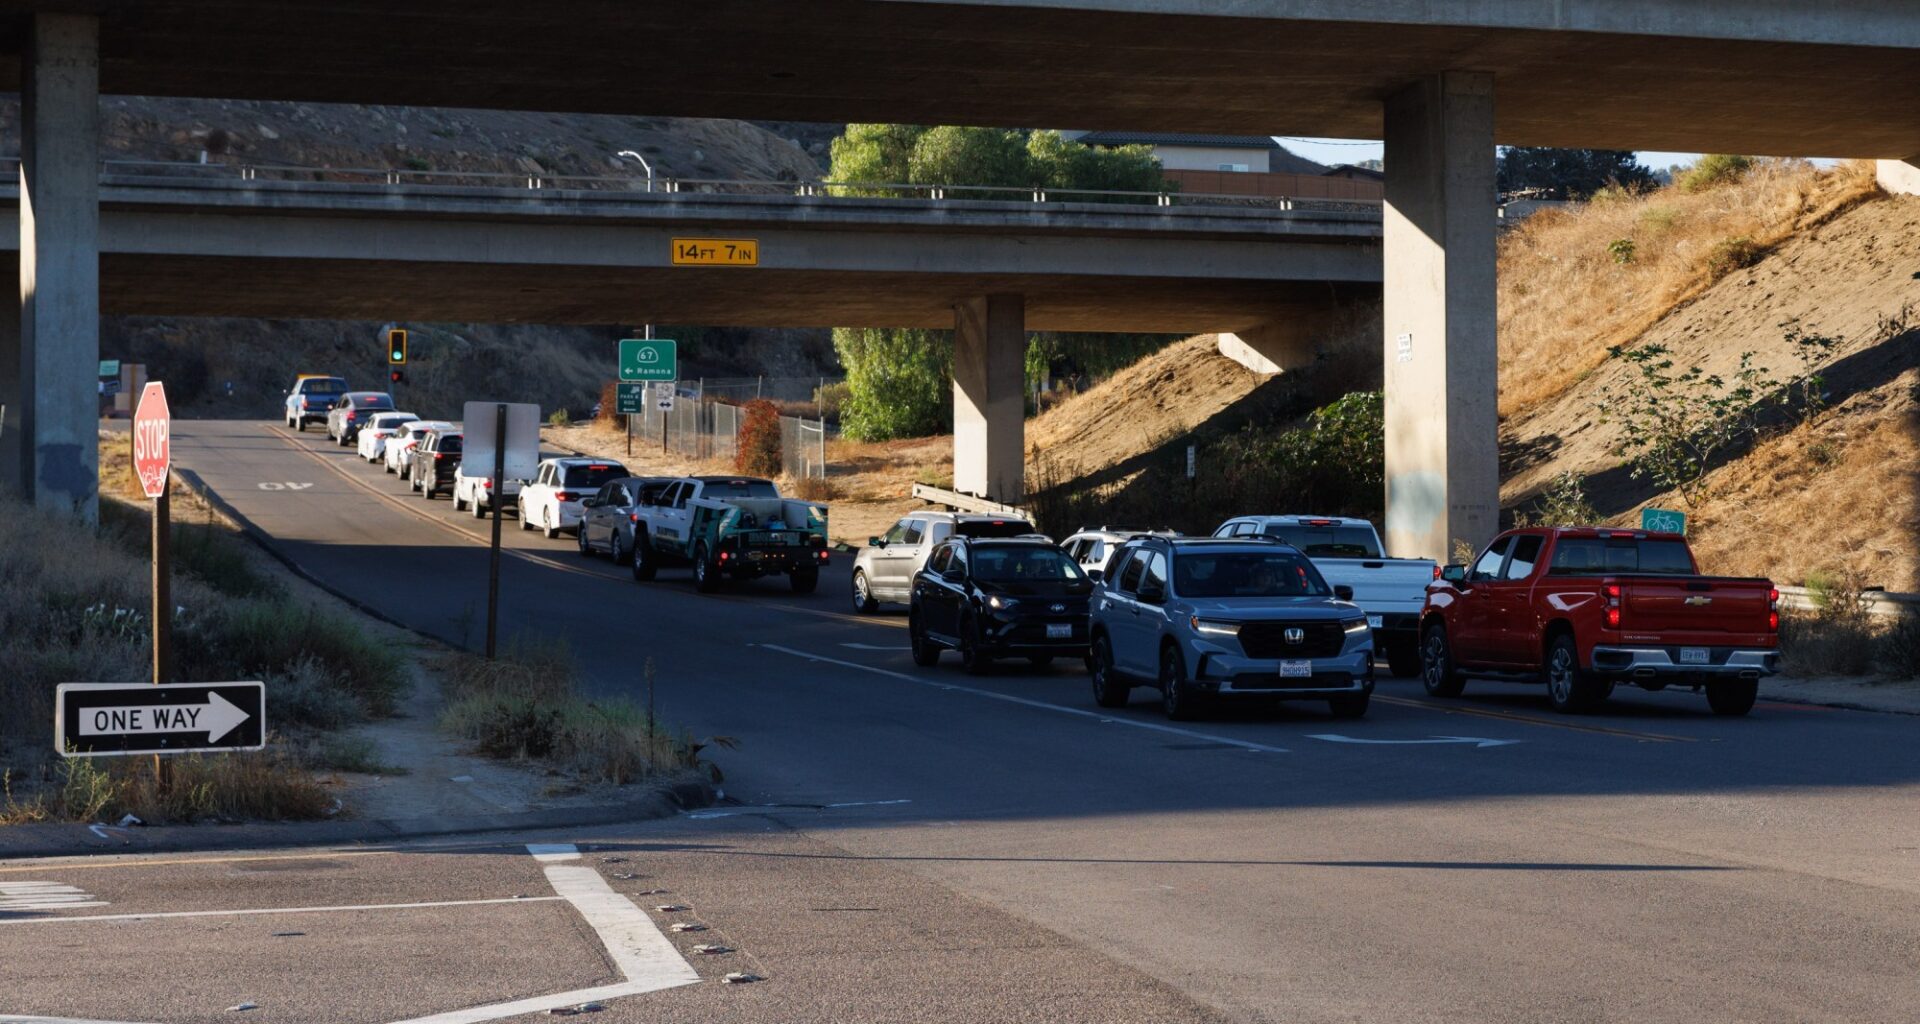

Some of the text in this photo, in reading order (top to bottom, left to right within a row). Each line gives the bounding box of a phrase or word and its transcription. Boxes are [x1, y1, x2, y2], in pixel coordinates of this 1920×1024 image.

[640, 351, 653, 360] 67
[637, 367, 672, 375] Ramona
[137, 419, 167, 461] STOP
[95, 707, 202, 732] ONE WAY
